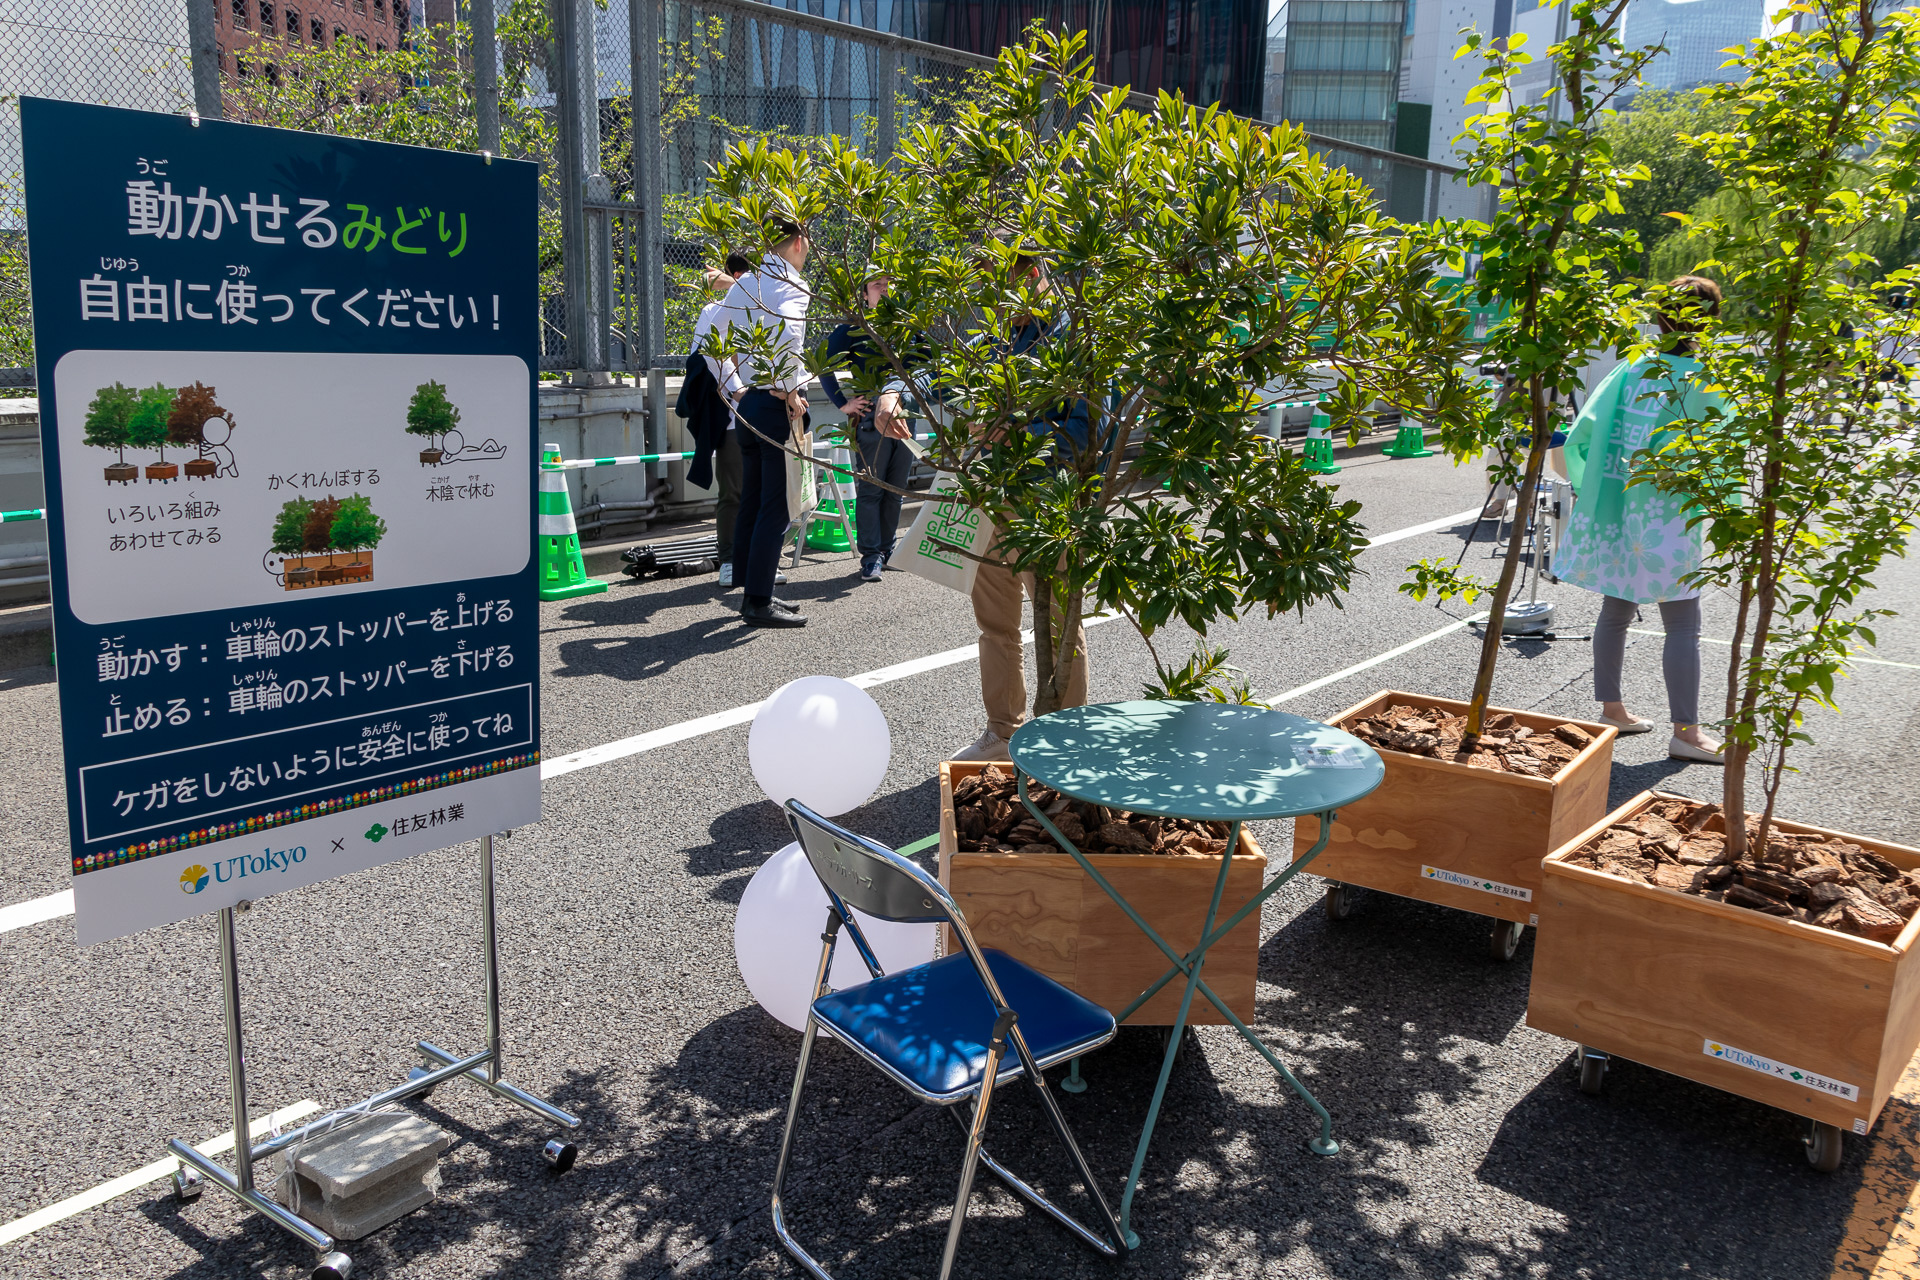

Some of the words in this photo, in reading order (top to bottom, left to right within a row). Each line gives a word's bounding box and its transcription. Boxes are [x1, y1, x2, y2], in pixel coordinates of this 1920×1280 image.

[136, 157, 168, 176] うご
[126, 180, 467, 258] 動かせるみどり
[101, 257, 139, 271] じゆう
[226, 265, 250, 277] つか
[80, 273, 500, 331] 自由に使ってください！
[268, 469, 380, 491] かくれんぼする
[431, 476, 450, 485] こかげ
[468, 474, 480, 482] やす
[426, 483, 495, 502] 木陰で休む
[108, 501, 221, 524] いろいろ組み
[110, 527, 222, 551] あわせてみる
[927, 519, 976, 546] GREEN
[457, 592, 466, 603] あ
[230, 617, 276, 633] しゃりん
[100, 637, 125, 650] うご
[457, 640, 467, 650] さ
[233, 669, 278, 686] しゃりん
[110, 694, 122, 706] と
[429, 712, 448, 724] つか
[362, 720, 402, 738] あんぜん
[113, 713, 513, 817] ケガをしないように安全に使ってね
[213, 846, 307, 884] UTokyo
[392, 803, 465, 837] 住友林業
[1436, 870, 1470, 886] UTokyo
[1725, 1048, 1771, 1071] UTokyo
[1805, 1075, 1852, 1097] 住友林業
